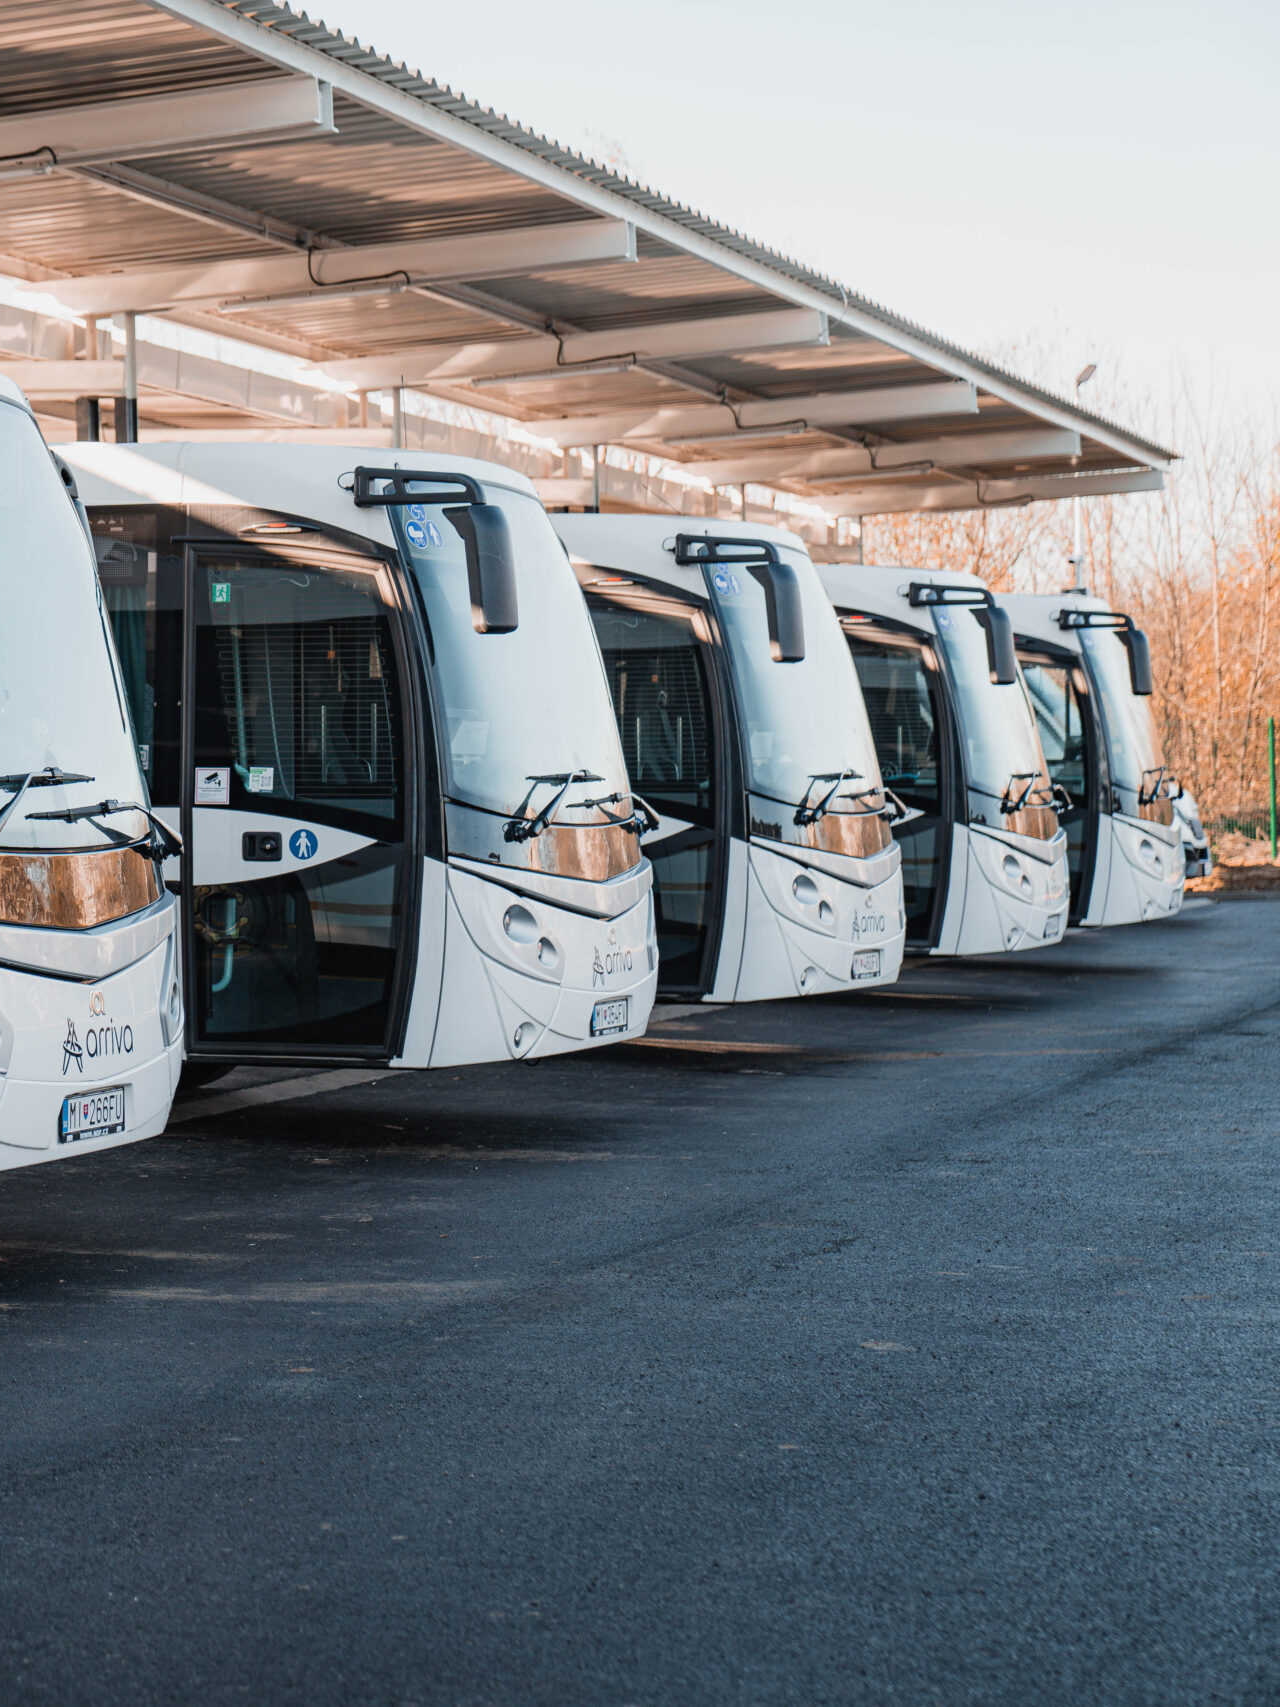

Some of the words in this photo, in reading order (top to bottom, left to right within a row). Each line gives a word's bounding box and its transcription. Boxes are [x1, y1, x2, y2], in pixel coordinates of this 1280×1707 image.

[605, 946, 633, 975] arriva
[86, 1017, 134, 1058] arriva
[69, 1101, 81, 1128] MI
[89, 1093, 122, 1126] 266FU
